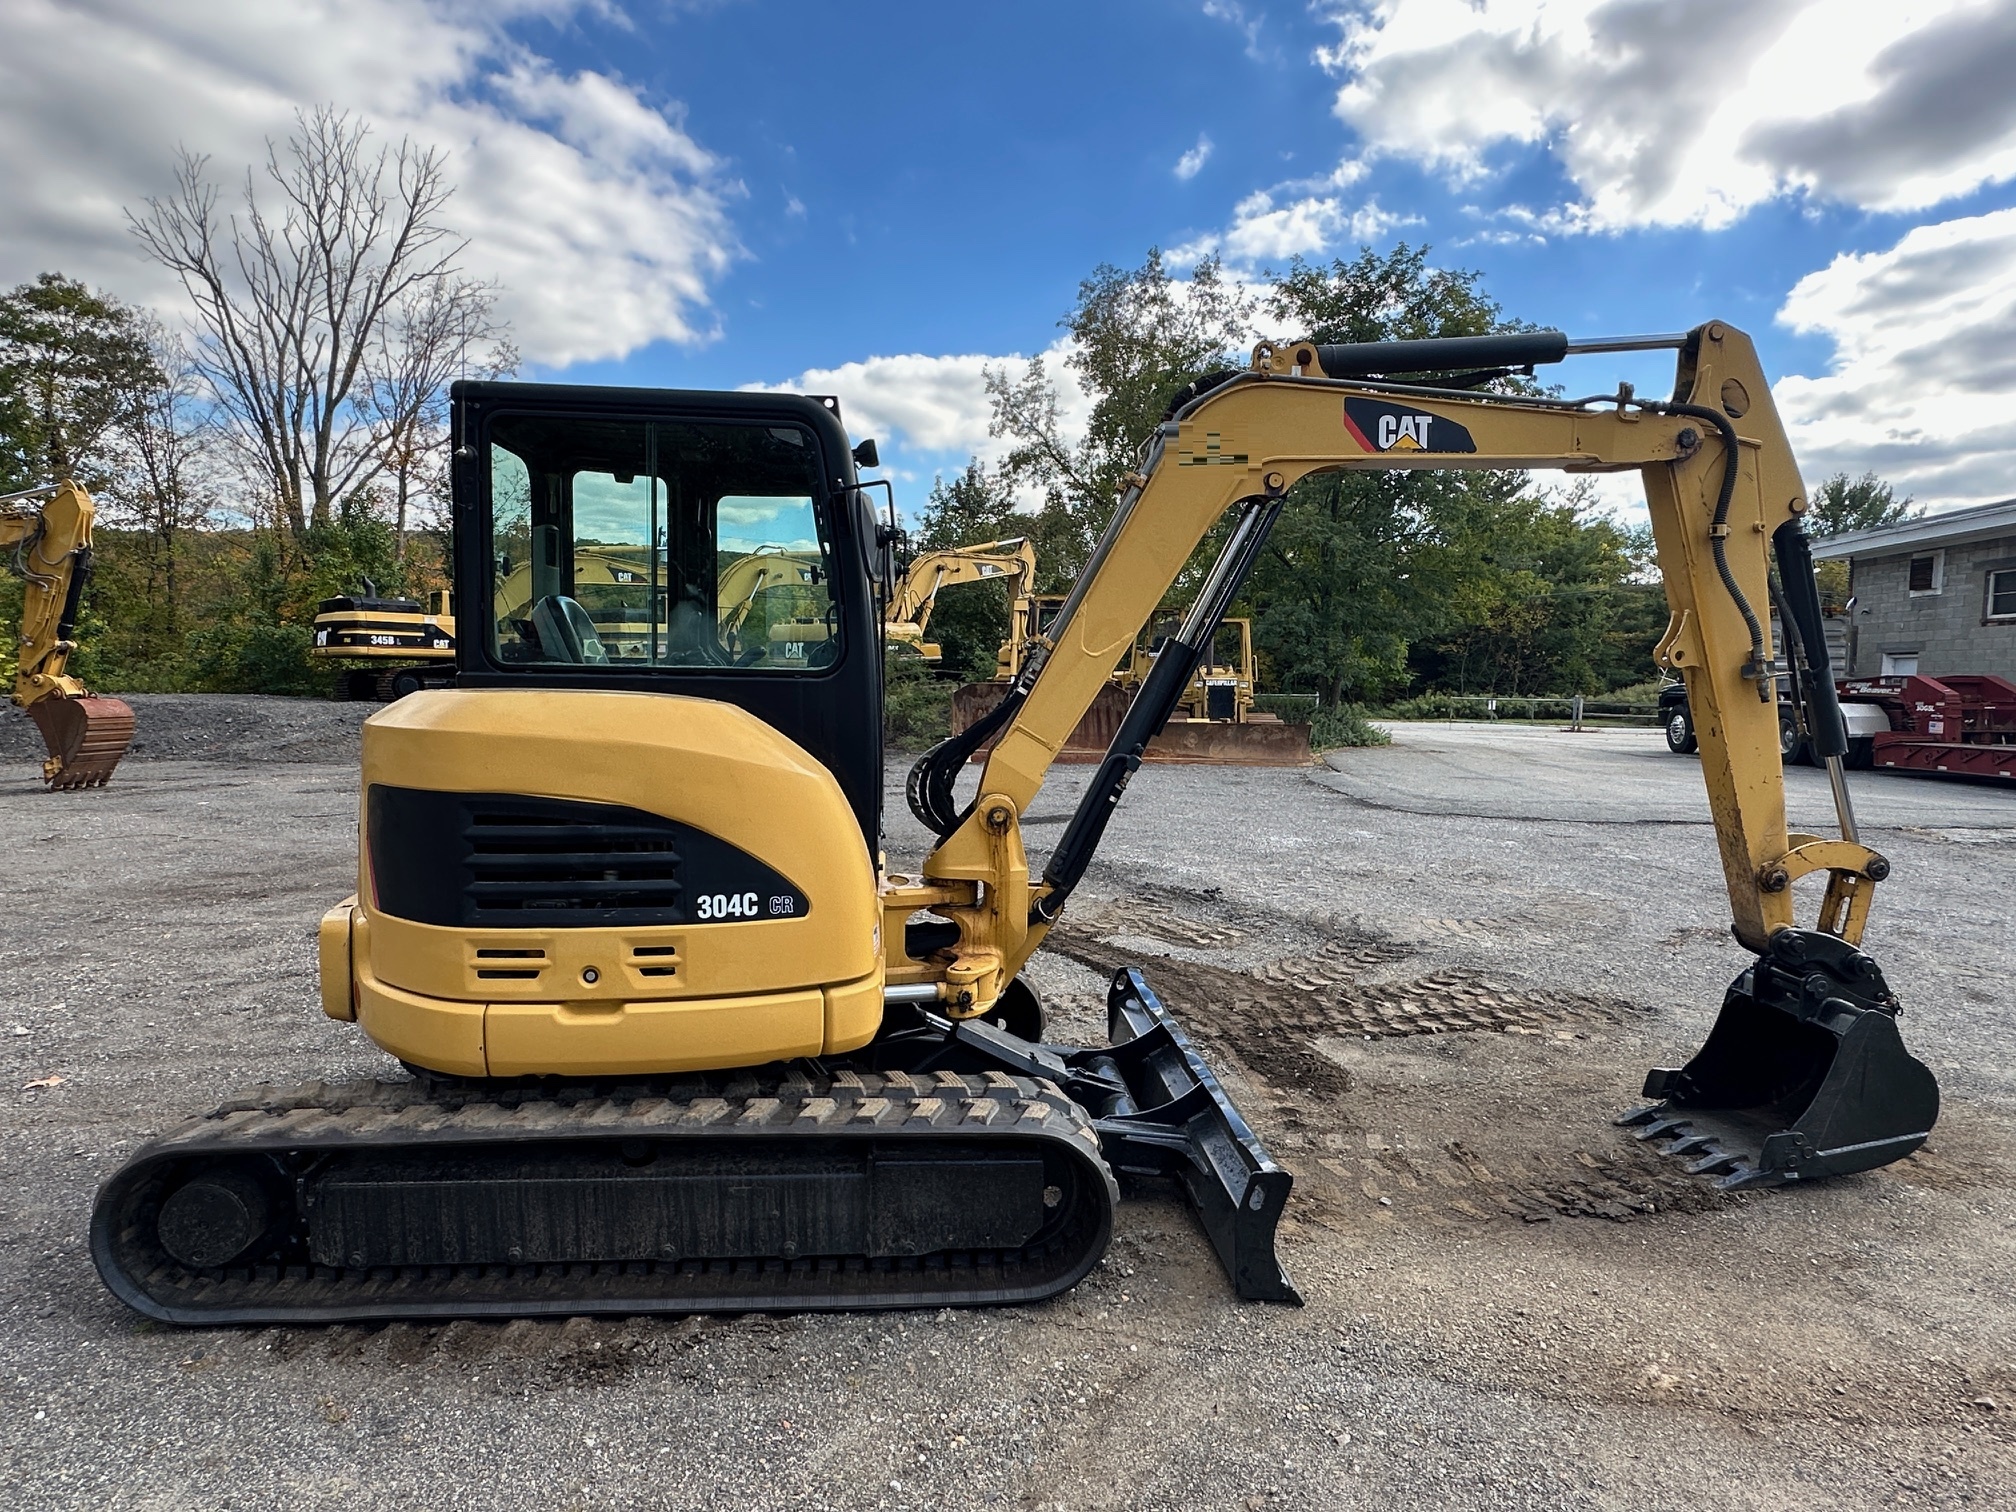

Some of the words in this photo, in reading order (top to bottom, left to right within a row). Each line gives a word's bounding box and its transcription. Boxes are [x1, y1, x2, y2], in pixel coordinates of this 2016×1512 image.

[1378, 414, 1433, 449] CAT
[617, 572, 632, 583] CAT
[370, 635, 394, 645] 345B
[433, 639, 450, 649] CAT
[785, 642, 804, 659] CAT
[697, 892, 758, 919] 304C
[769, 896, 794, 914] CR
